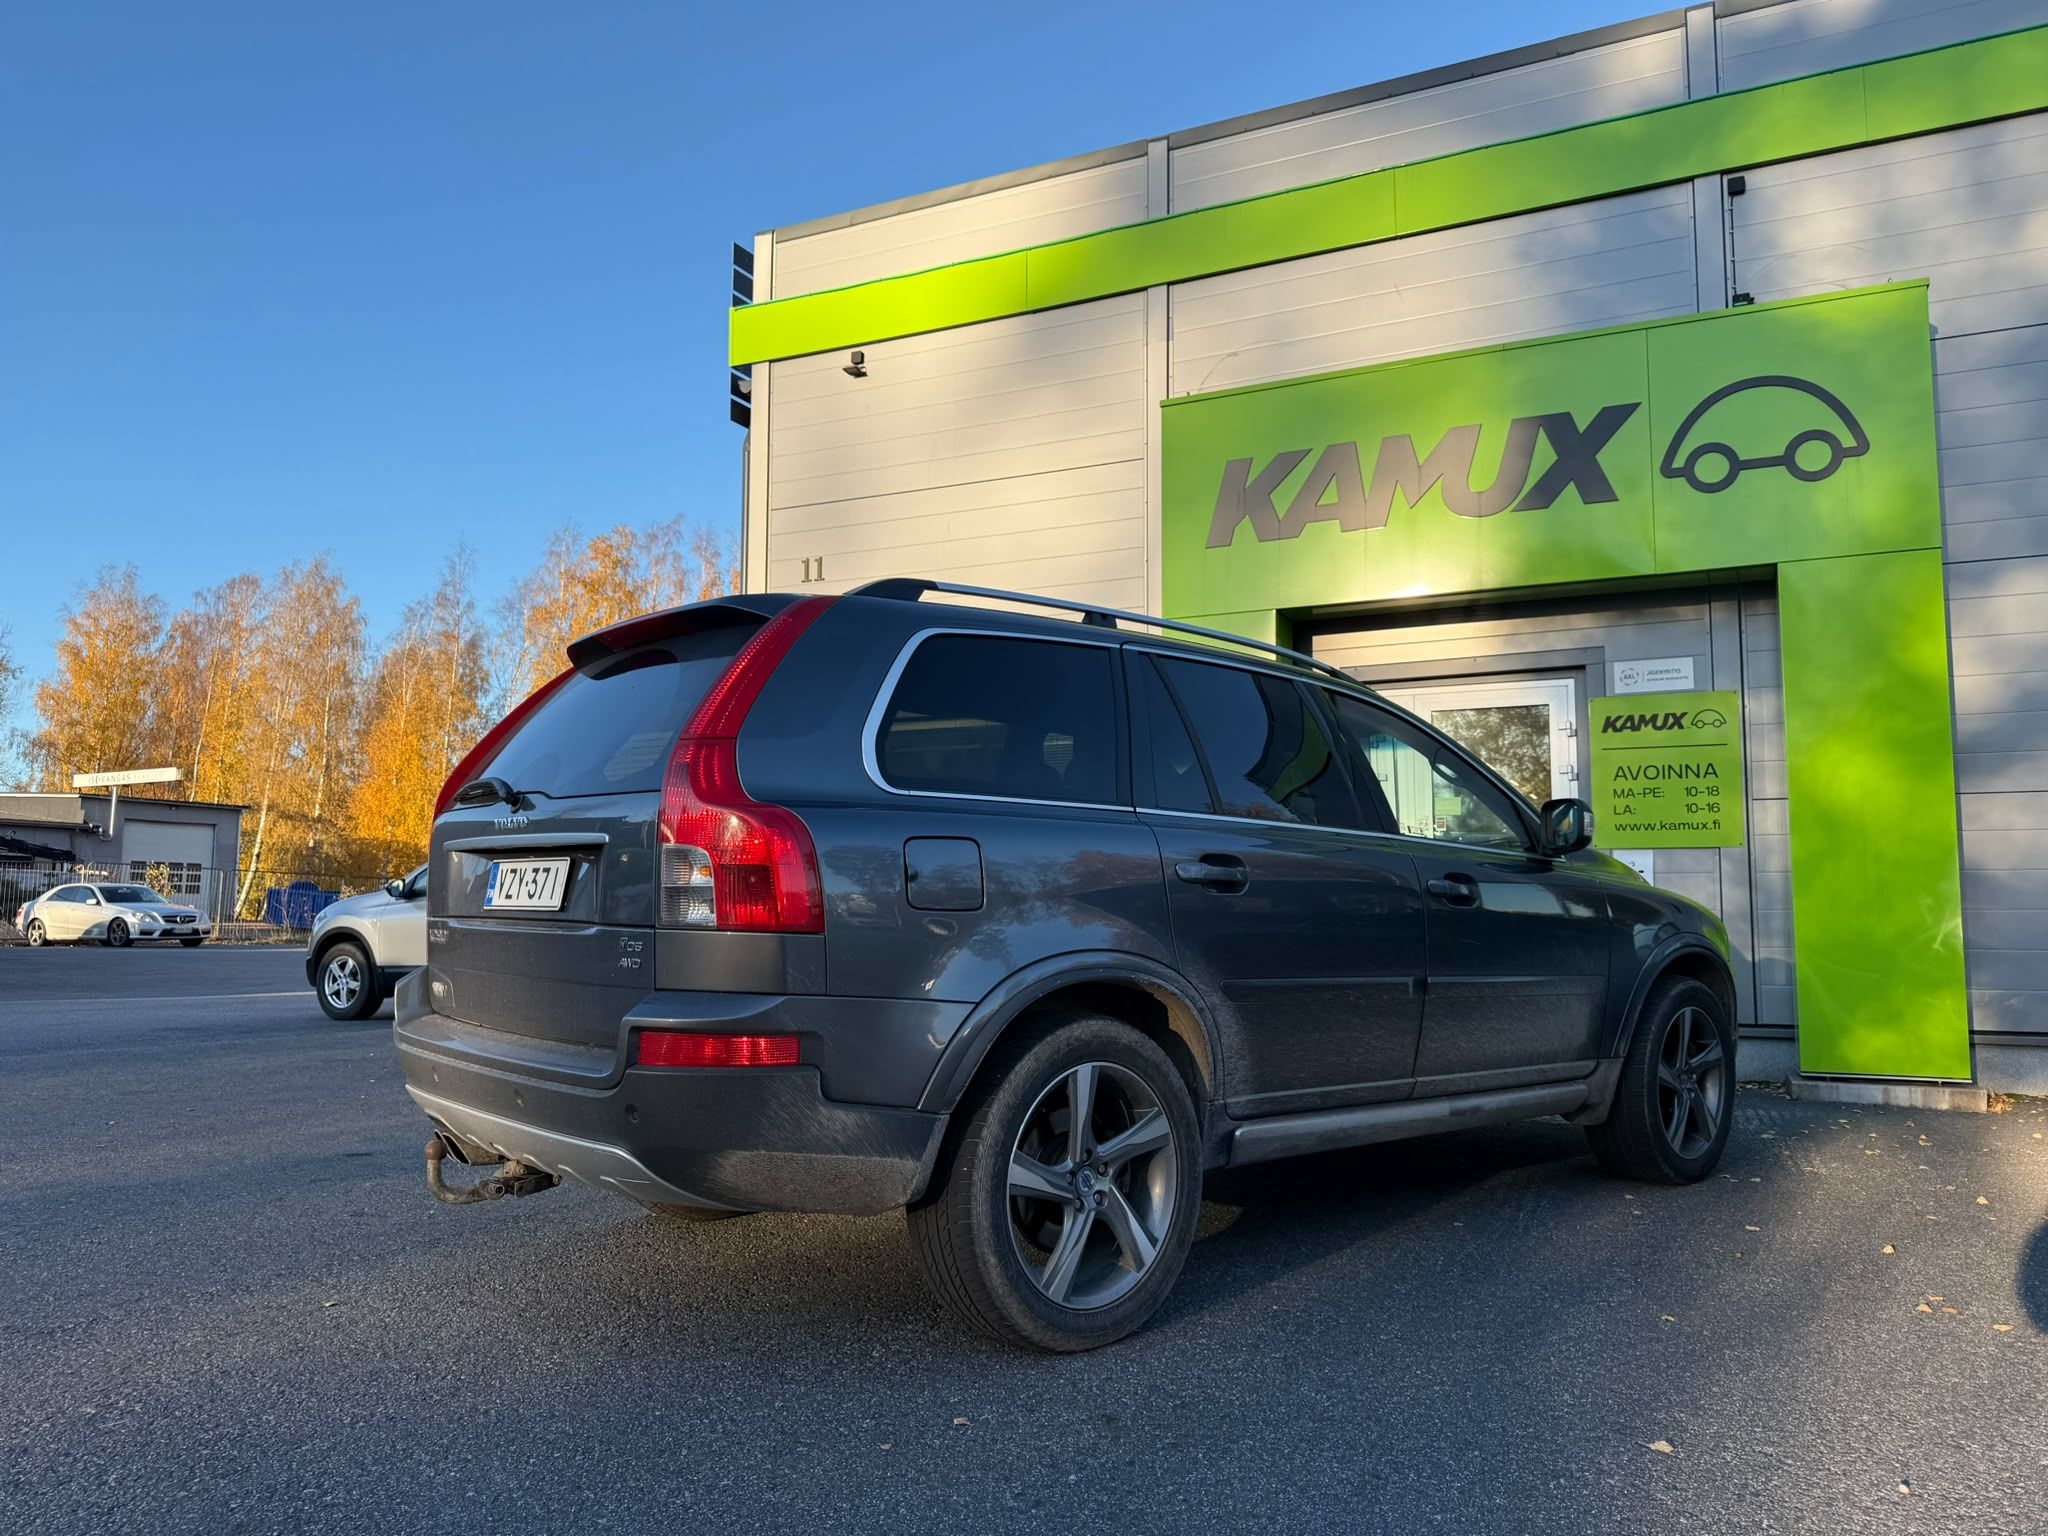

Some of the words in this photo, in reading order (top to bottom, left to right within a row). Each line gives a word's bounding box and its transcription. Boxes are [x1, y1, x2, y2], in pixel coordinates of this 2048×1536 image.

[1205, 401, 1642, 549] KAMUX
[801, 556, 825, 583] 11
[1601, 711, 1689, 733] KAMUX
[1613, 763, 1719, 781] AVOINNA
[1613, 787, 1665, 799] MA-PE:
[1684, 786, 1720, 797] 10-18
[1613, 804, 1637, 816] LA:
[1684, 802, 1720, 814] 10-16
[1614, 818, 1721, 832] www.kamux.fi
[498, 866, 559, 900] VZY-371
